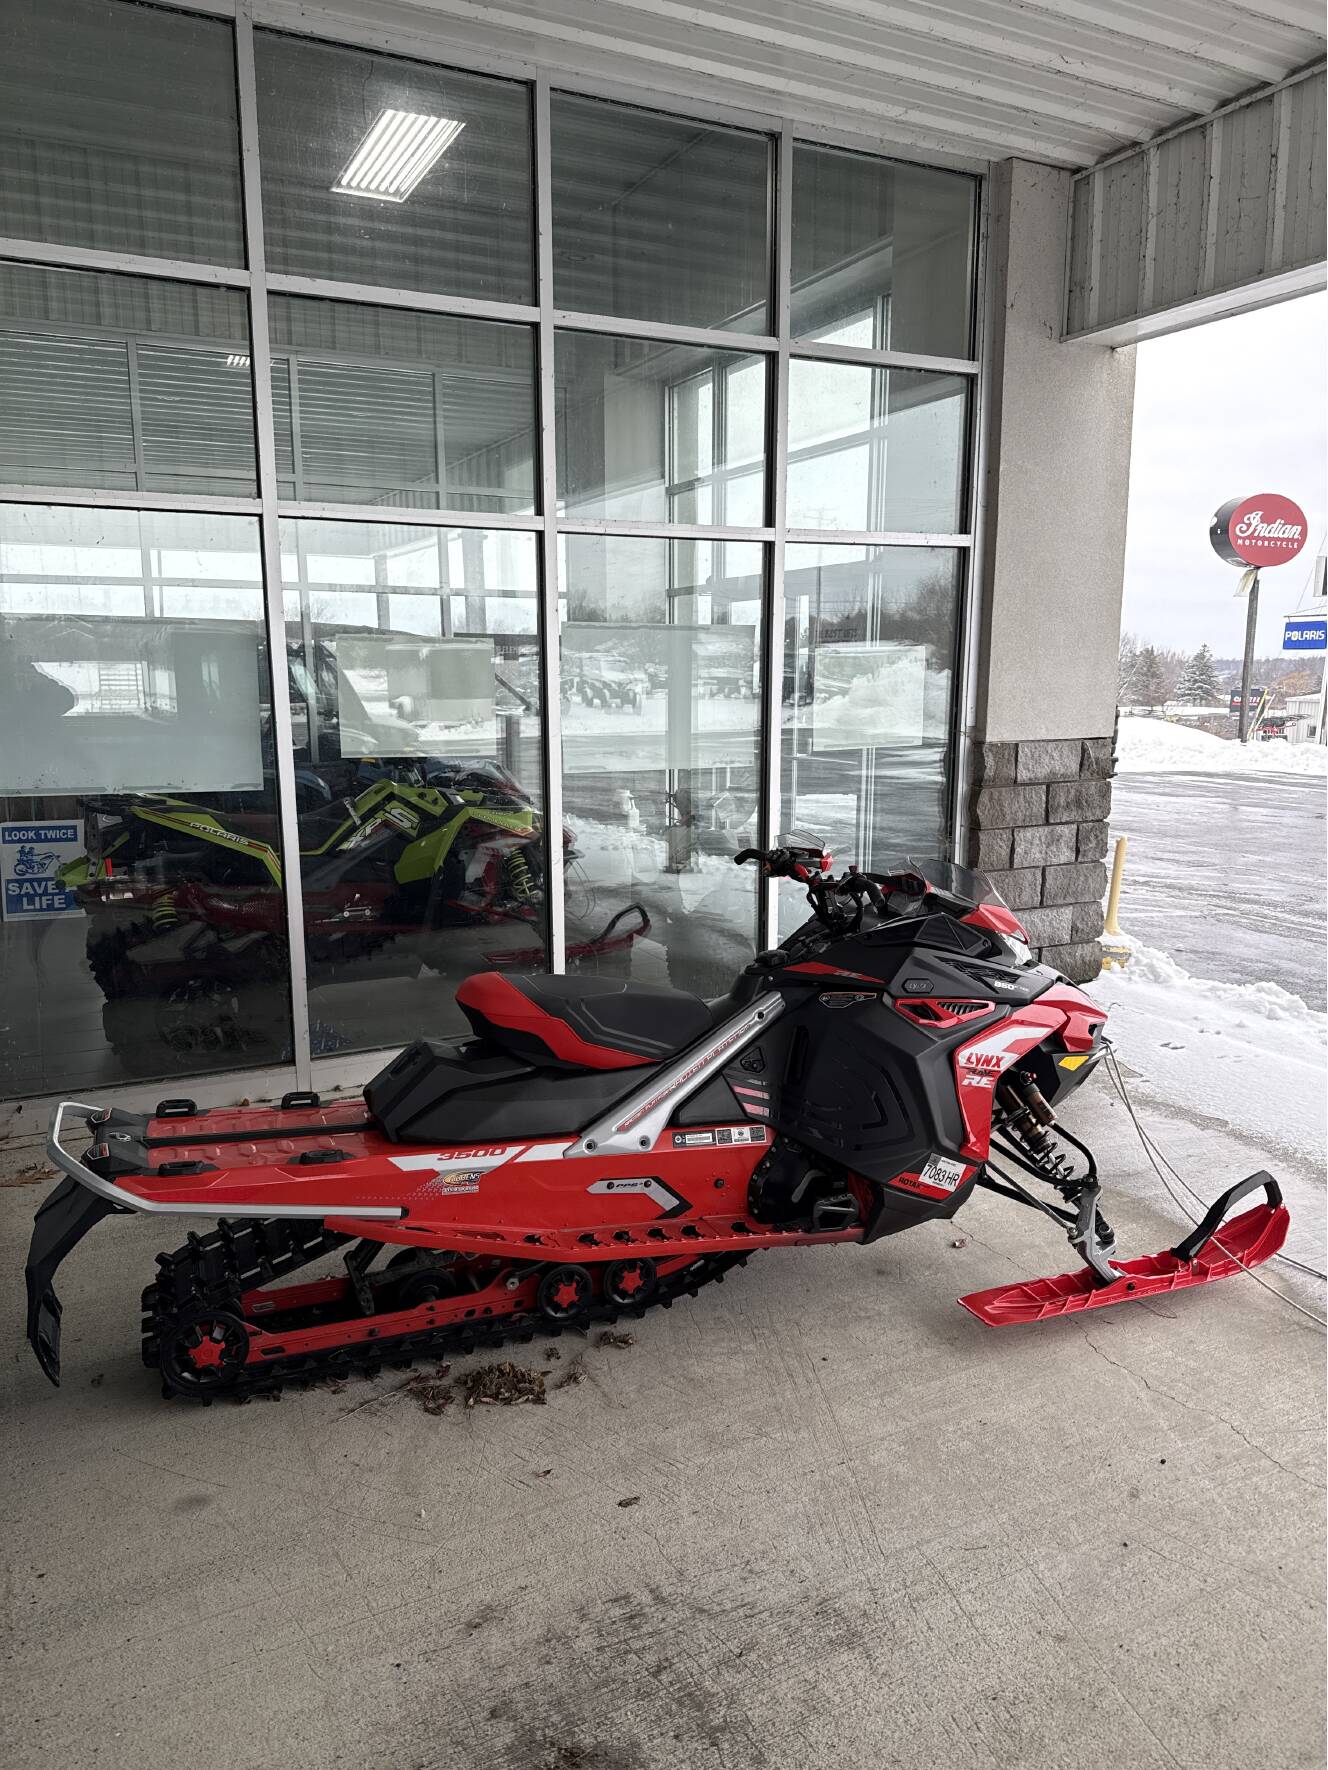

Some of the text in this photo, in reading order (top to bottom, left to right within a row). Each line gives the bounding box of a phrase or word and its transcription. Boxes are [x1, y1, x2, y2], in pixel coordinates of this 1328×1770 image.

[1235, 511, 1302, 539] Indian
[1237, 539, 1298, 549] MOTORCYCLE
[1285, 630, 1325, 641] POLARIS
[5, 829, 75, 841] LOOK TWICE
[190, 822, 249, 845] POLARIS
[7, 881, 60, 895] SAVE
[22, 895, 67, 910] LIFE
[964, 1052, 1006, 1069] LYNX
[962, 1074, 994, 1088] RE
[436, 1148, 507, 1161] 3500
